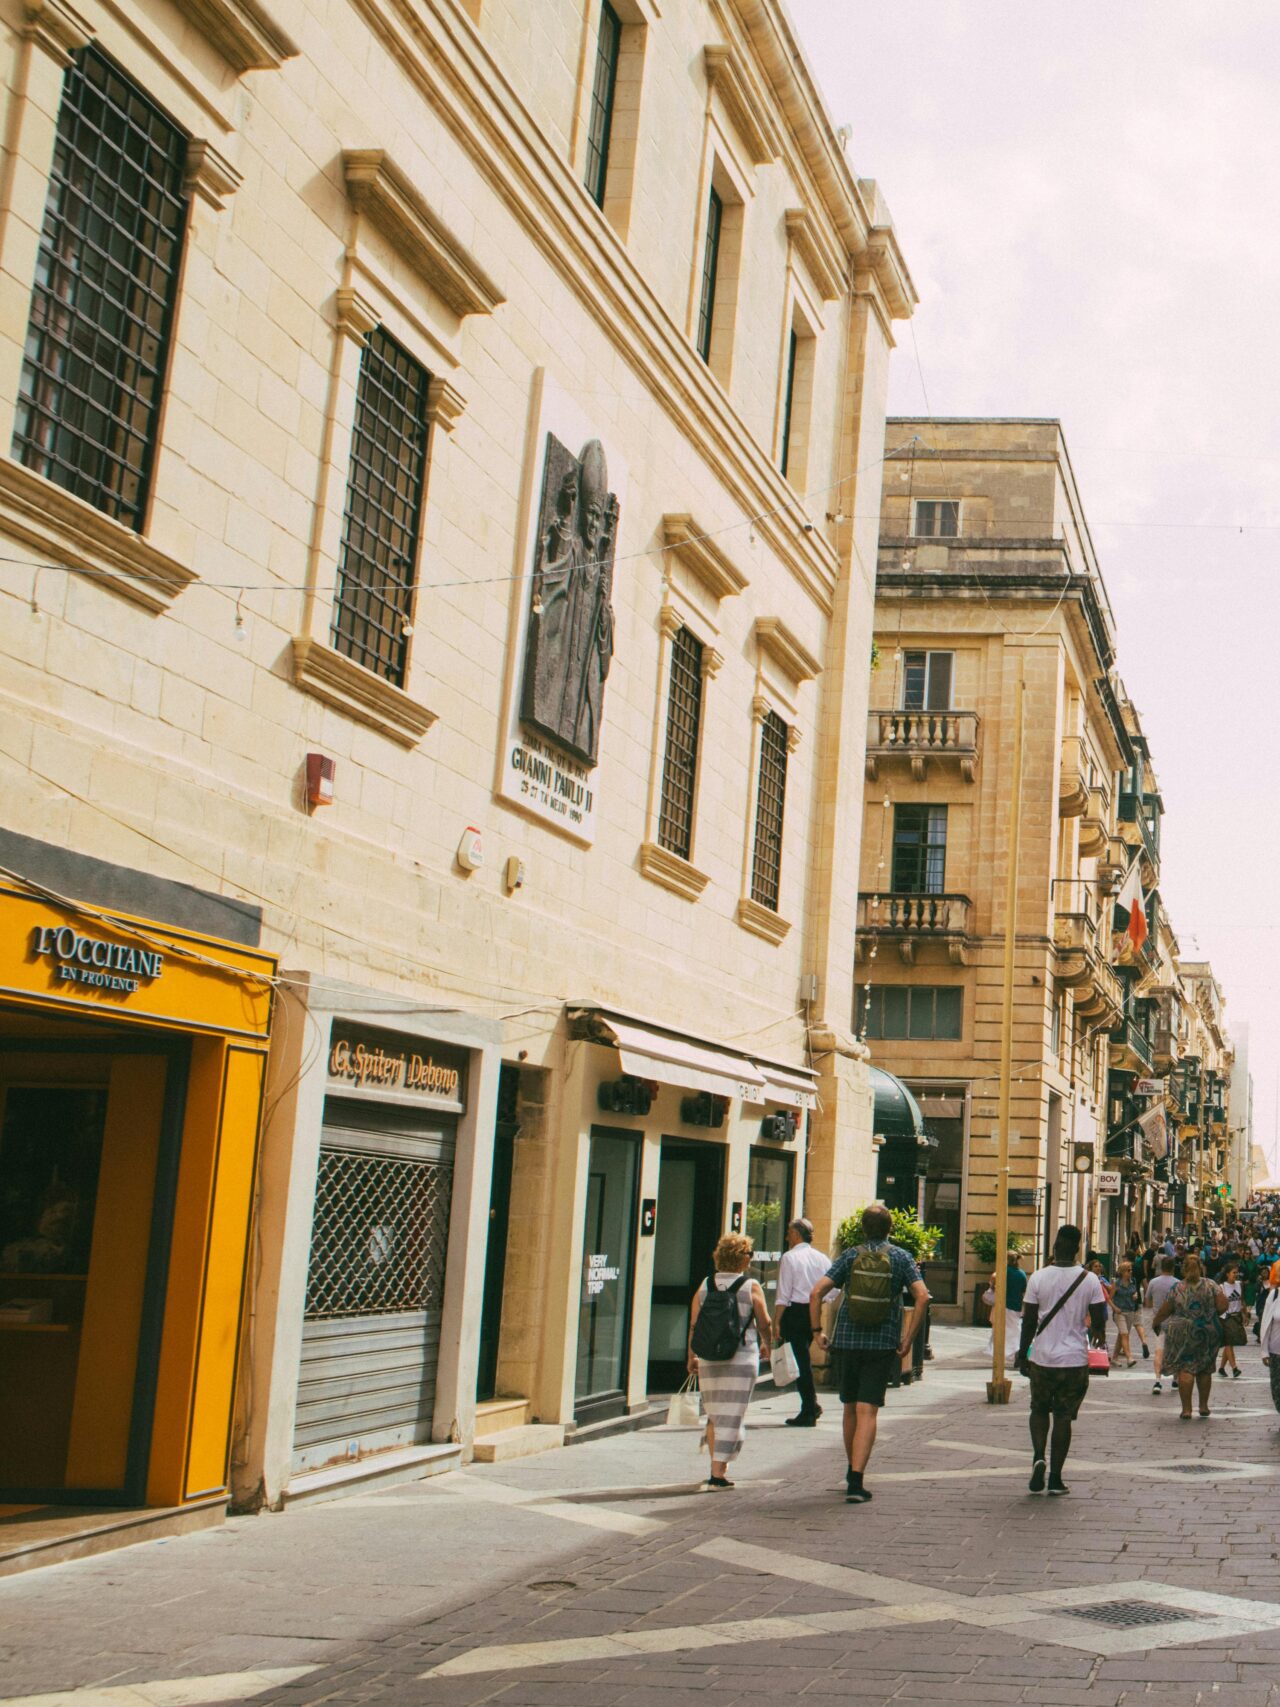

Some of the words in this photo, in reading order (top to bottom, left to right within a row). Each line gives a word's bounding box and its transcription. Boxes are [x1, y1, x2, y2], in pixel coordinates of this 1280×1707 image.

[37, 926, 164, 978] L'OCCITANE
[60, 965, 77, 980] EN
[81, 969, 139, 992] PROVENCE
[333, 1040, 352, 1071] G.
[354, 1043, 405, 1085] Spiteri
[409, 1054, 458, 1089] Debono
[1100, 1175, 1118, 1183] BOV
[589, 1254, 608, 1267] VERY
[588, 1280, 604, 1294] TRIP
